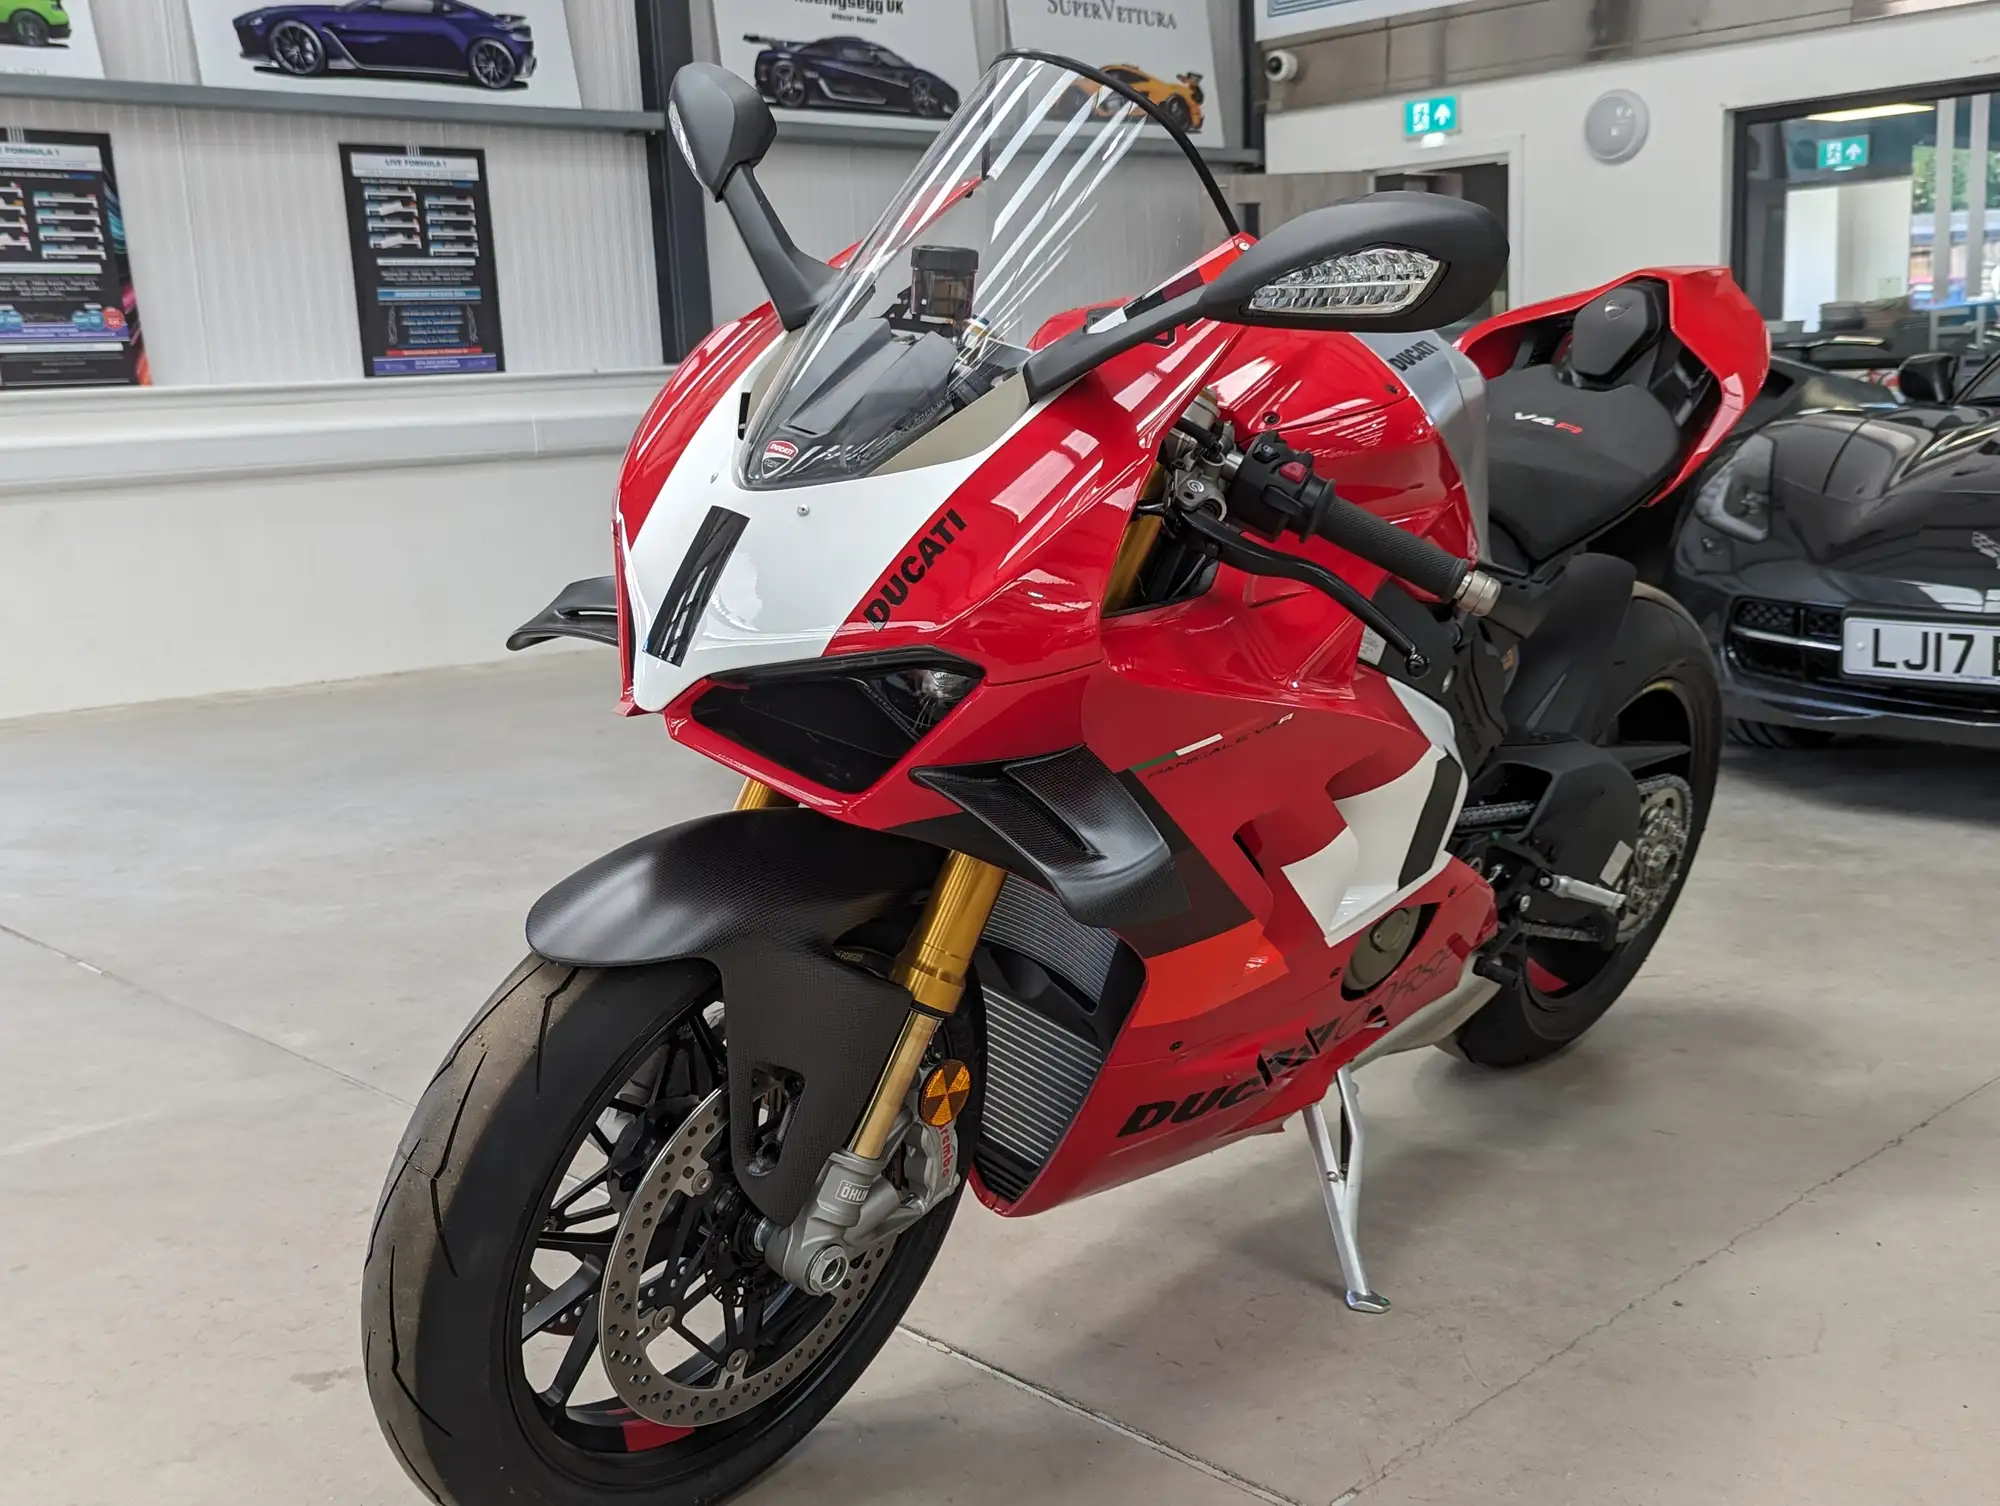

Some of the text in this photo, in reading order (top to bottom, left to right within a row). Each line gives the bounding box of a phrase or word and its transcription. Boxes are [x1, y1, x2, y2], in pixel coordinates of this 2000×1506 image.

[1387, 340, 1439, 372] DUCATI
[769, 443, 795, 456] DUCATI
[863, 507, 968, 633] DUCATI
[1872, 628, 1975, 674] LJ17
[936, 1126, 954, 1178] rembo
